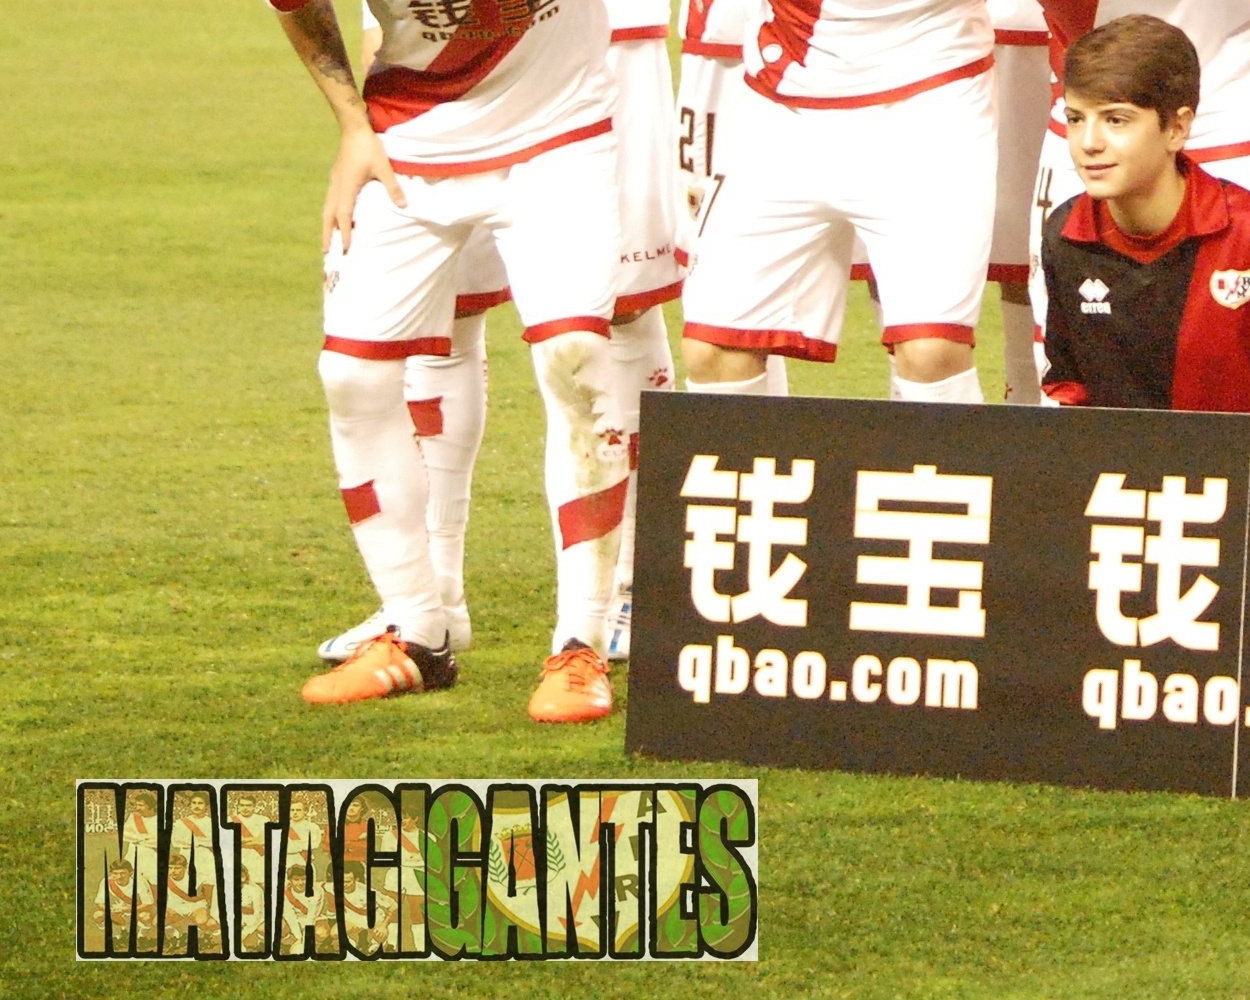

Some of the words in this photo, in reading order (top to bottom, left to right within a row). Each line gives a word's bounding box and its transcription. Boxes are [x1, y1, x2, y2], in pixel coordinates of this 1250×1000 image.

[679, 106, 716, 177] 21
[681, 455, 993, 637] 钱宝
[678, 635, 978, 710] qbao.com
